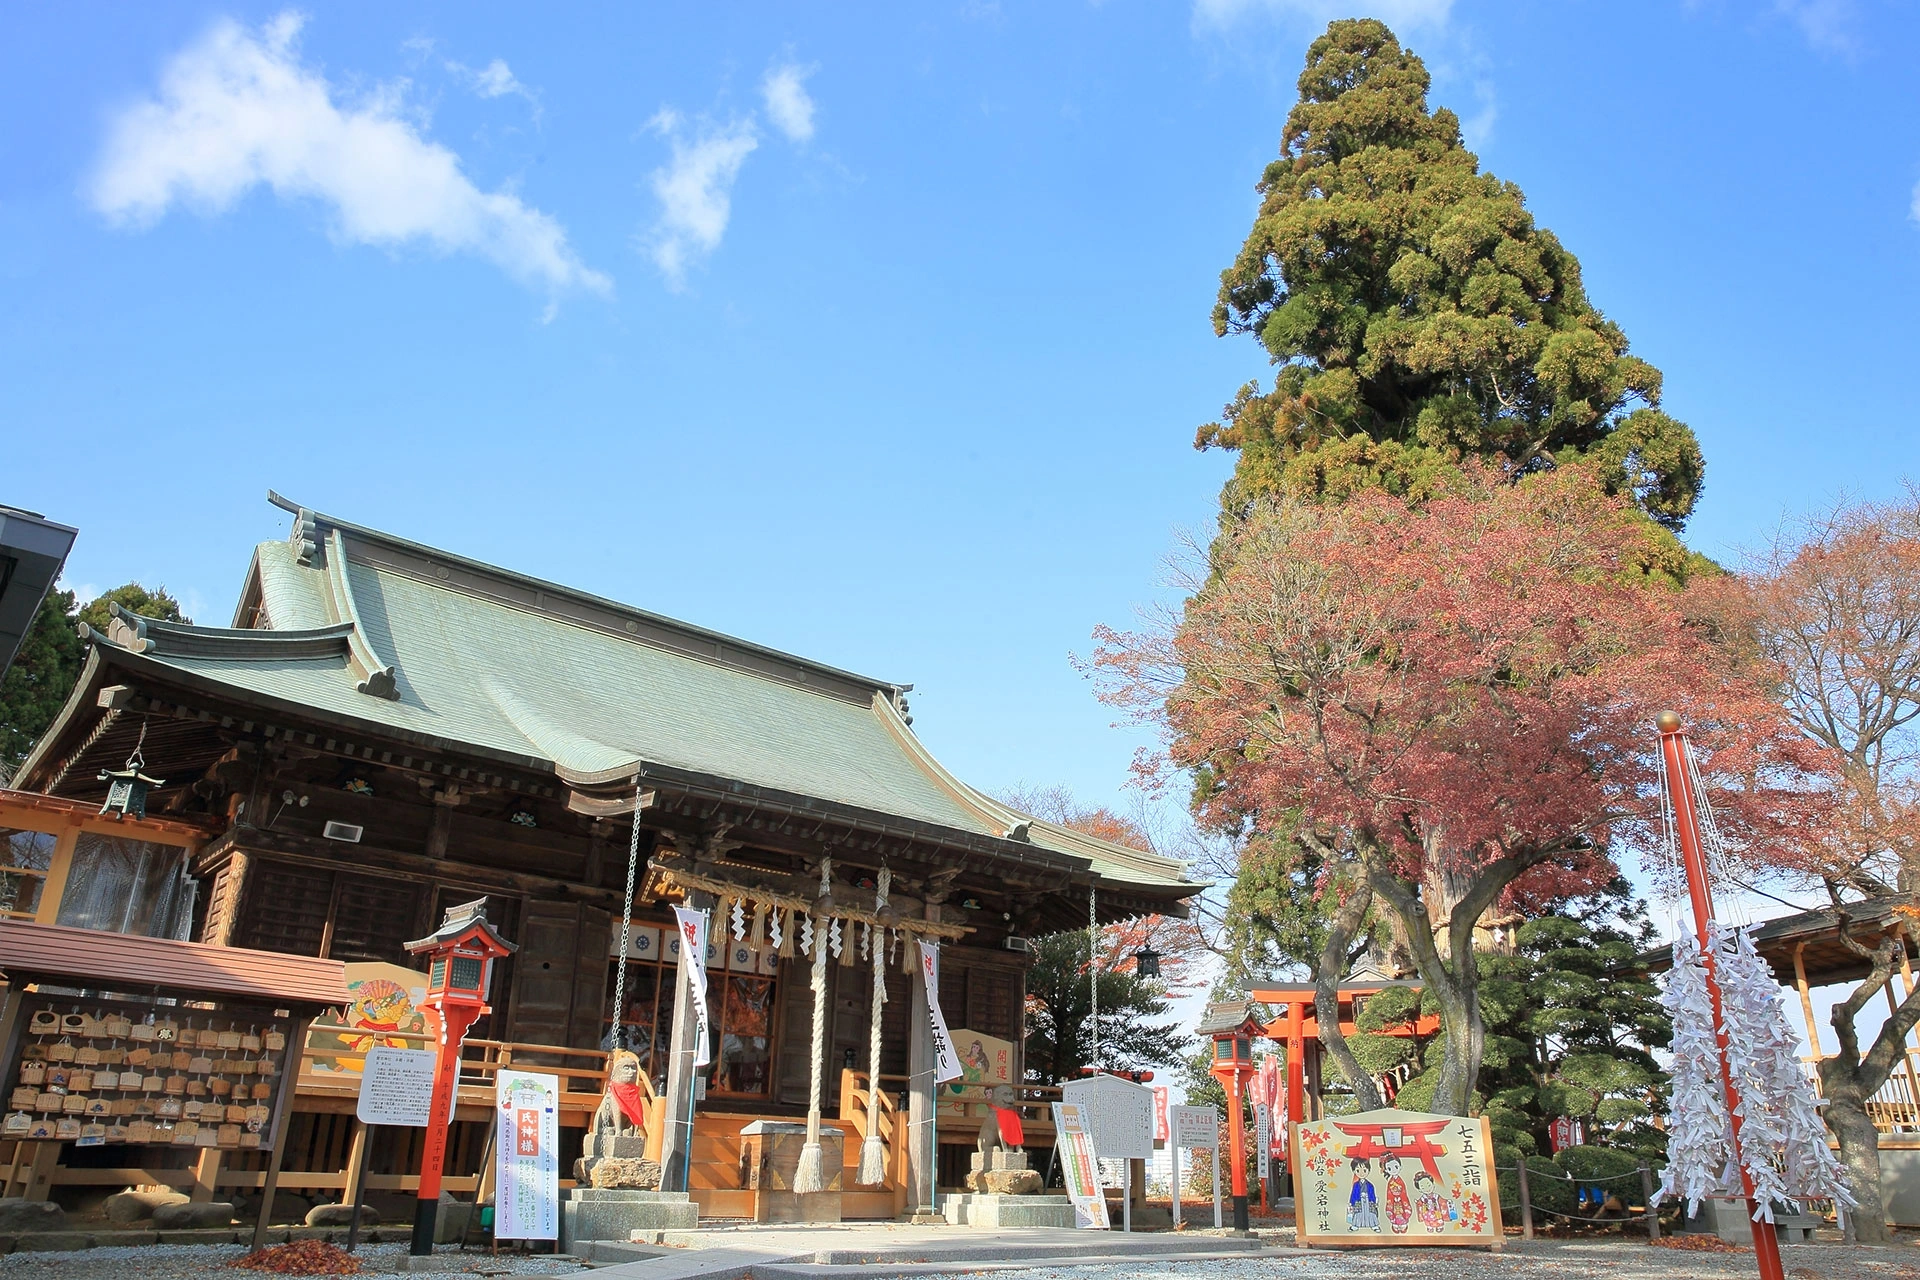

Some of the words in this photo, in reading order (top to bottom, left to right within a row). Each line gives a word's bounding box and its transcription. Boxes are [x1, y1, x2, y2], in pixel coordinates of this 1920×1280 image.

[684, 921, 697, 946] 祝
[444, 1064, 452, 1073] 献
[996, 1050, 1007, 1080] 開運
[432, 1082, 449, 1171] 平成九年二月二十四日
[521, 1111, 534, 1152] 氏神様
[1314, 1155, 1326, 1177] 仙台
[1457, 1124, 1481, 1187] 七五三詣
[1314, 1180, 1331, 1232] 愛宕神社
